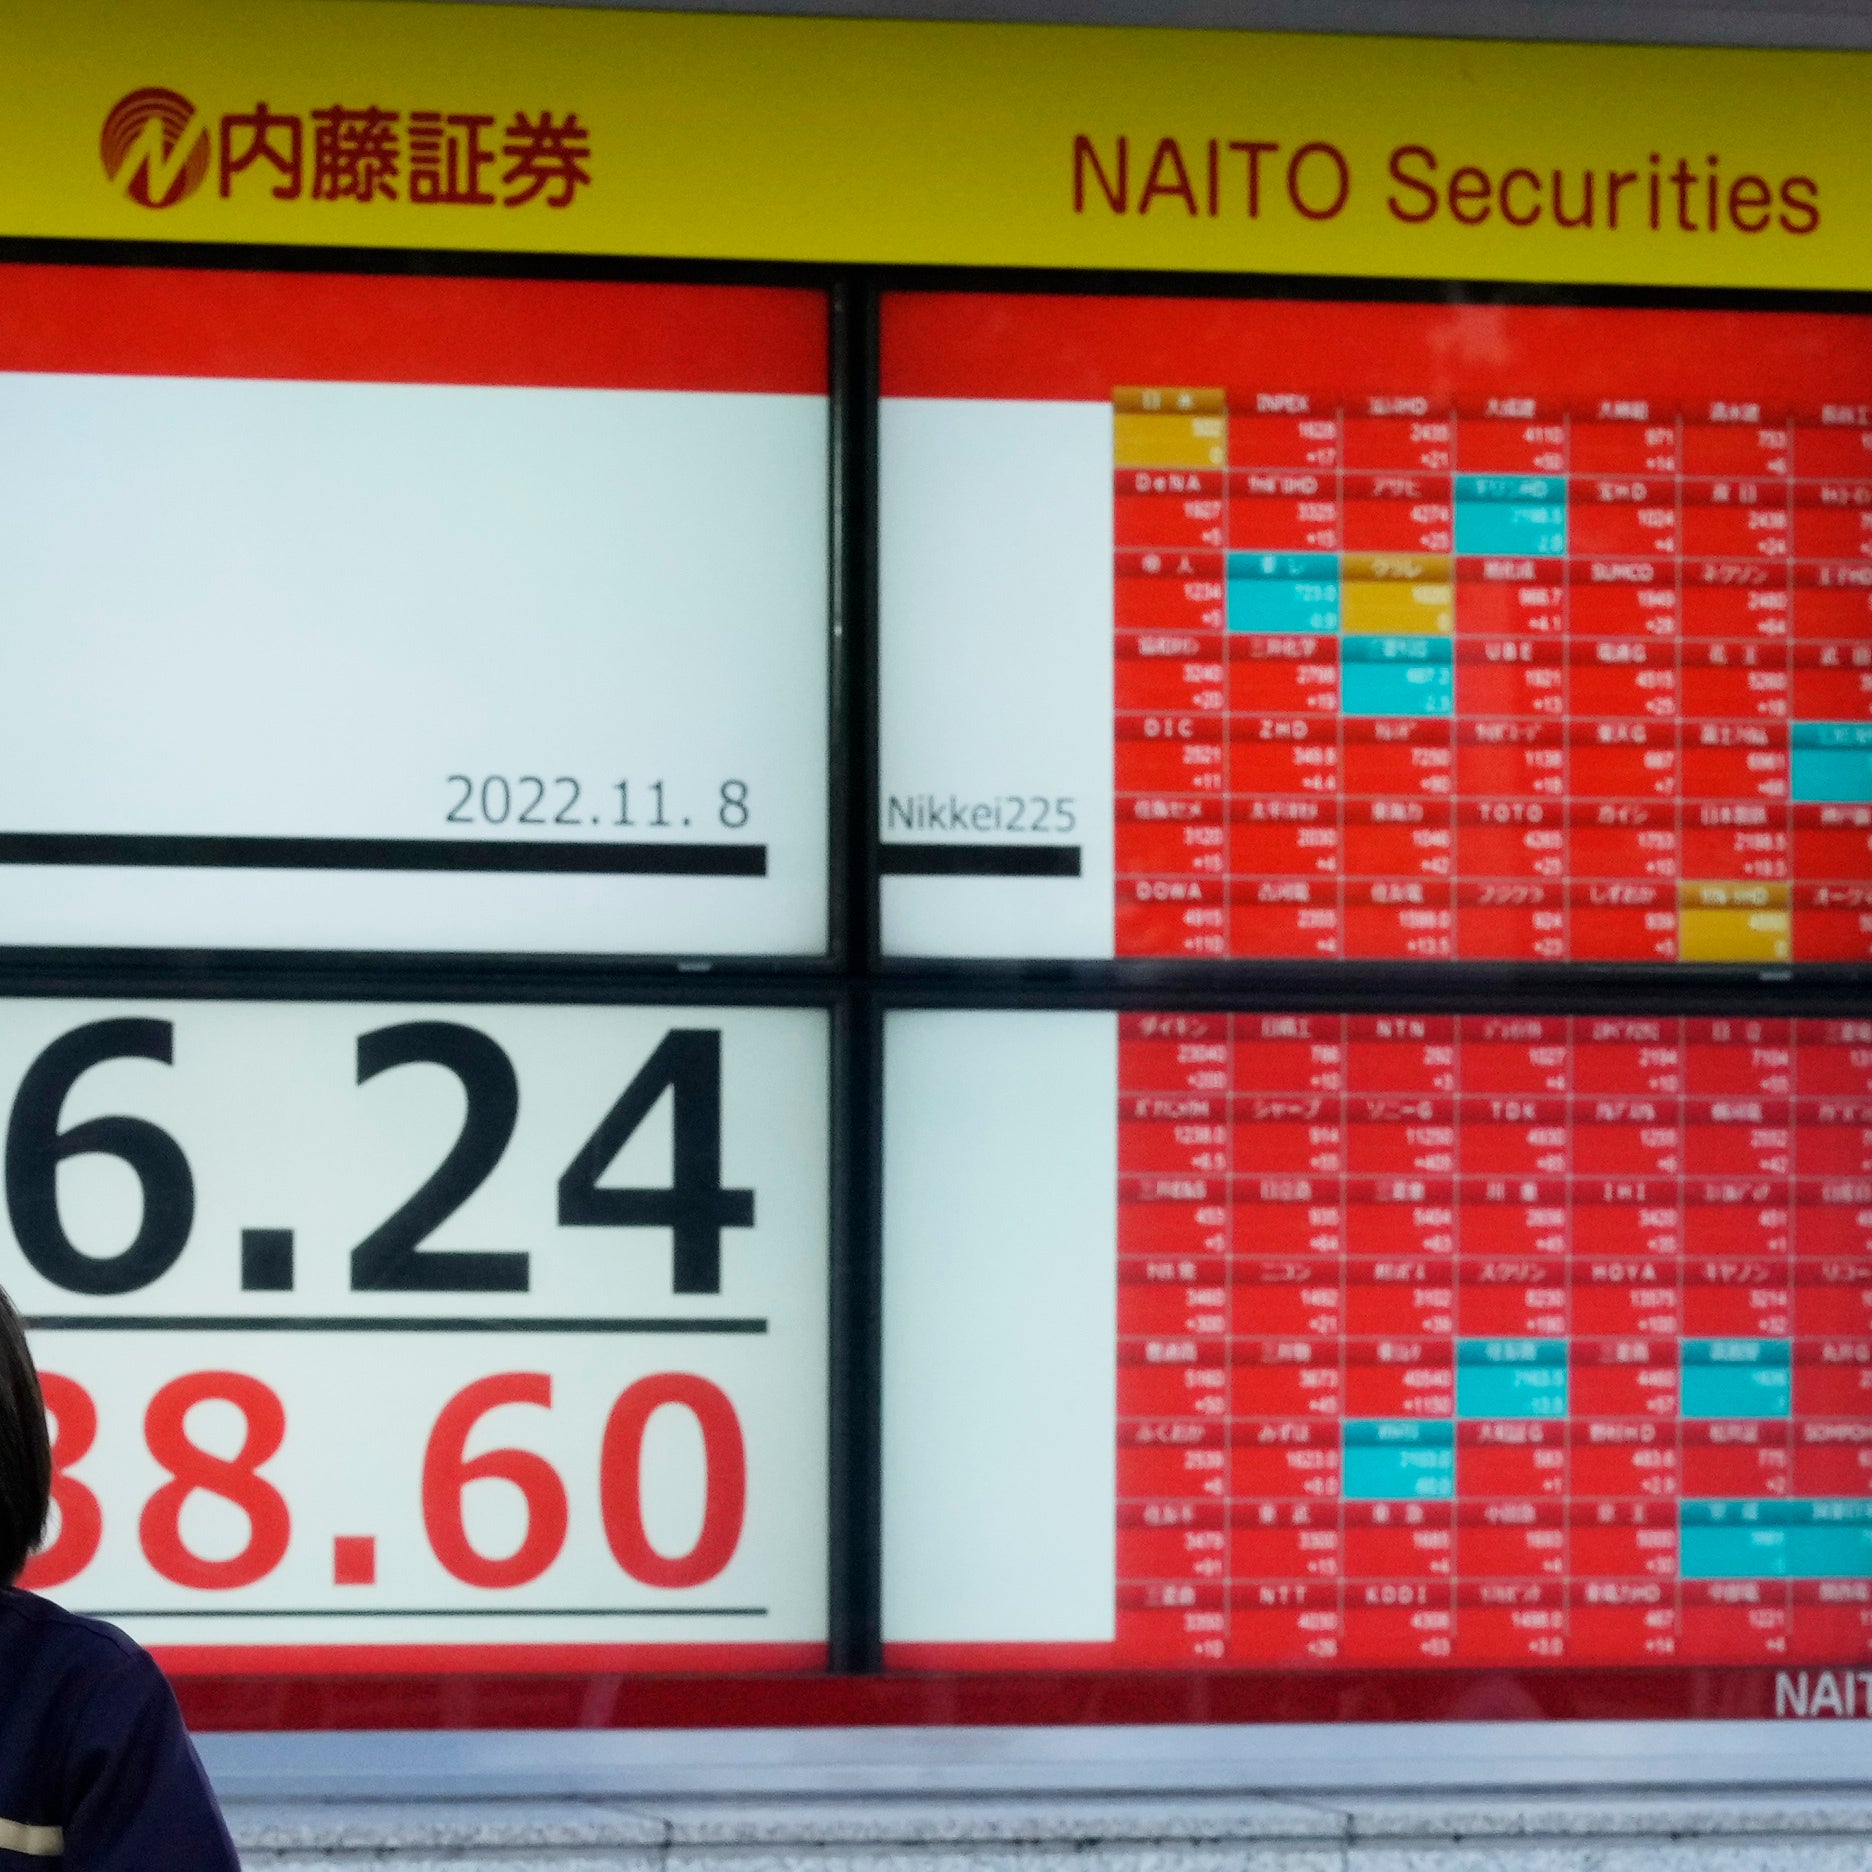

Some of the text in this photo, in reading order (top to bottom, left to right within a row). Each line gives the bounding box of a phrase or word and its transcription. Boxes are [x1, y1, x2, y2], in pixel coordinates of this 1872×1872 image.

[219, 101, 592, 208] 内藤証券
[1072, 133, 1821, 236] NAITO Securities
[1145, 717, 1197, 737] DIC
[887, 795, 1077, 833] Nikkei225
[1478, 803, 1545, 823] TOTO
[1373, 1019, 1425, 1039] NTN
[1590, 1262, 1657, 1282] HOYA
[1260, 1585, 1312, 1605] NTT
